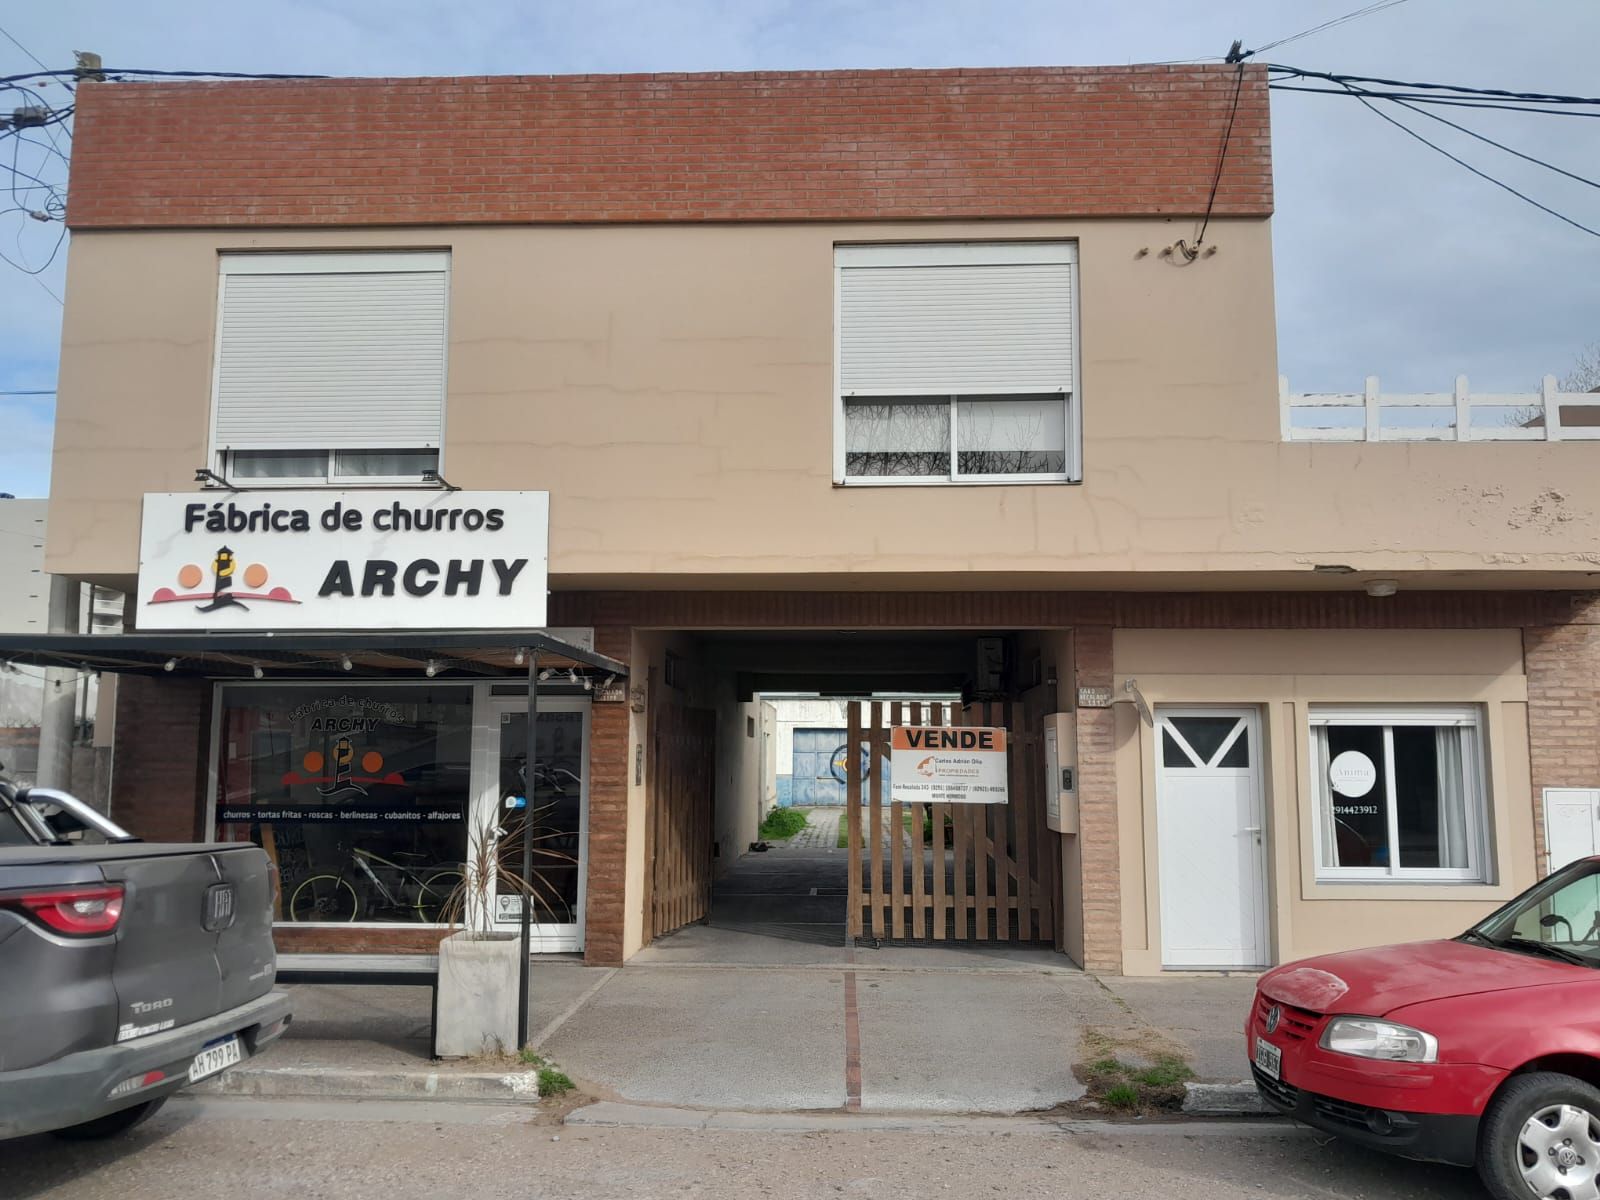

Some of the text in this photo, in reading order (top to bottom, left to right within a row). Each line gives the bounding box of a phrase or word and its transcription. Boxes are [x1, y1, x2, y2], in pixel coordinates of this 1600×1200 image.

[184, 500, 505, 533] Fábrica de churros
[317, 558, 529, 597] ARCHY
[339, 695, 354, 707] de
[358, 697, 406, 724] churros
[311, 717, 381, 732] ARCHY
[906, 729, 993, 749] VENDE
[223, 811, 251, 819] churros
[257, 811, 281, 819] tortas
[282, 811, 302, 819] fritas
[340, 811, 378, 820] berlinesas
[384, 811, 421, 820] cubanitos
[427, 811, 461, 821] alfajores
[205, 1049, 224, 1071] 799
[225, 1041, 240, 1061] PA
